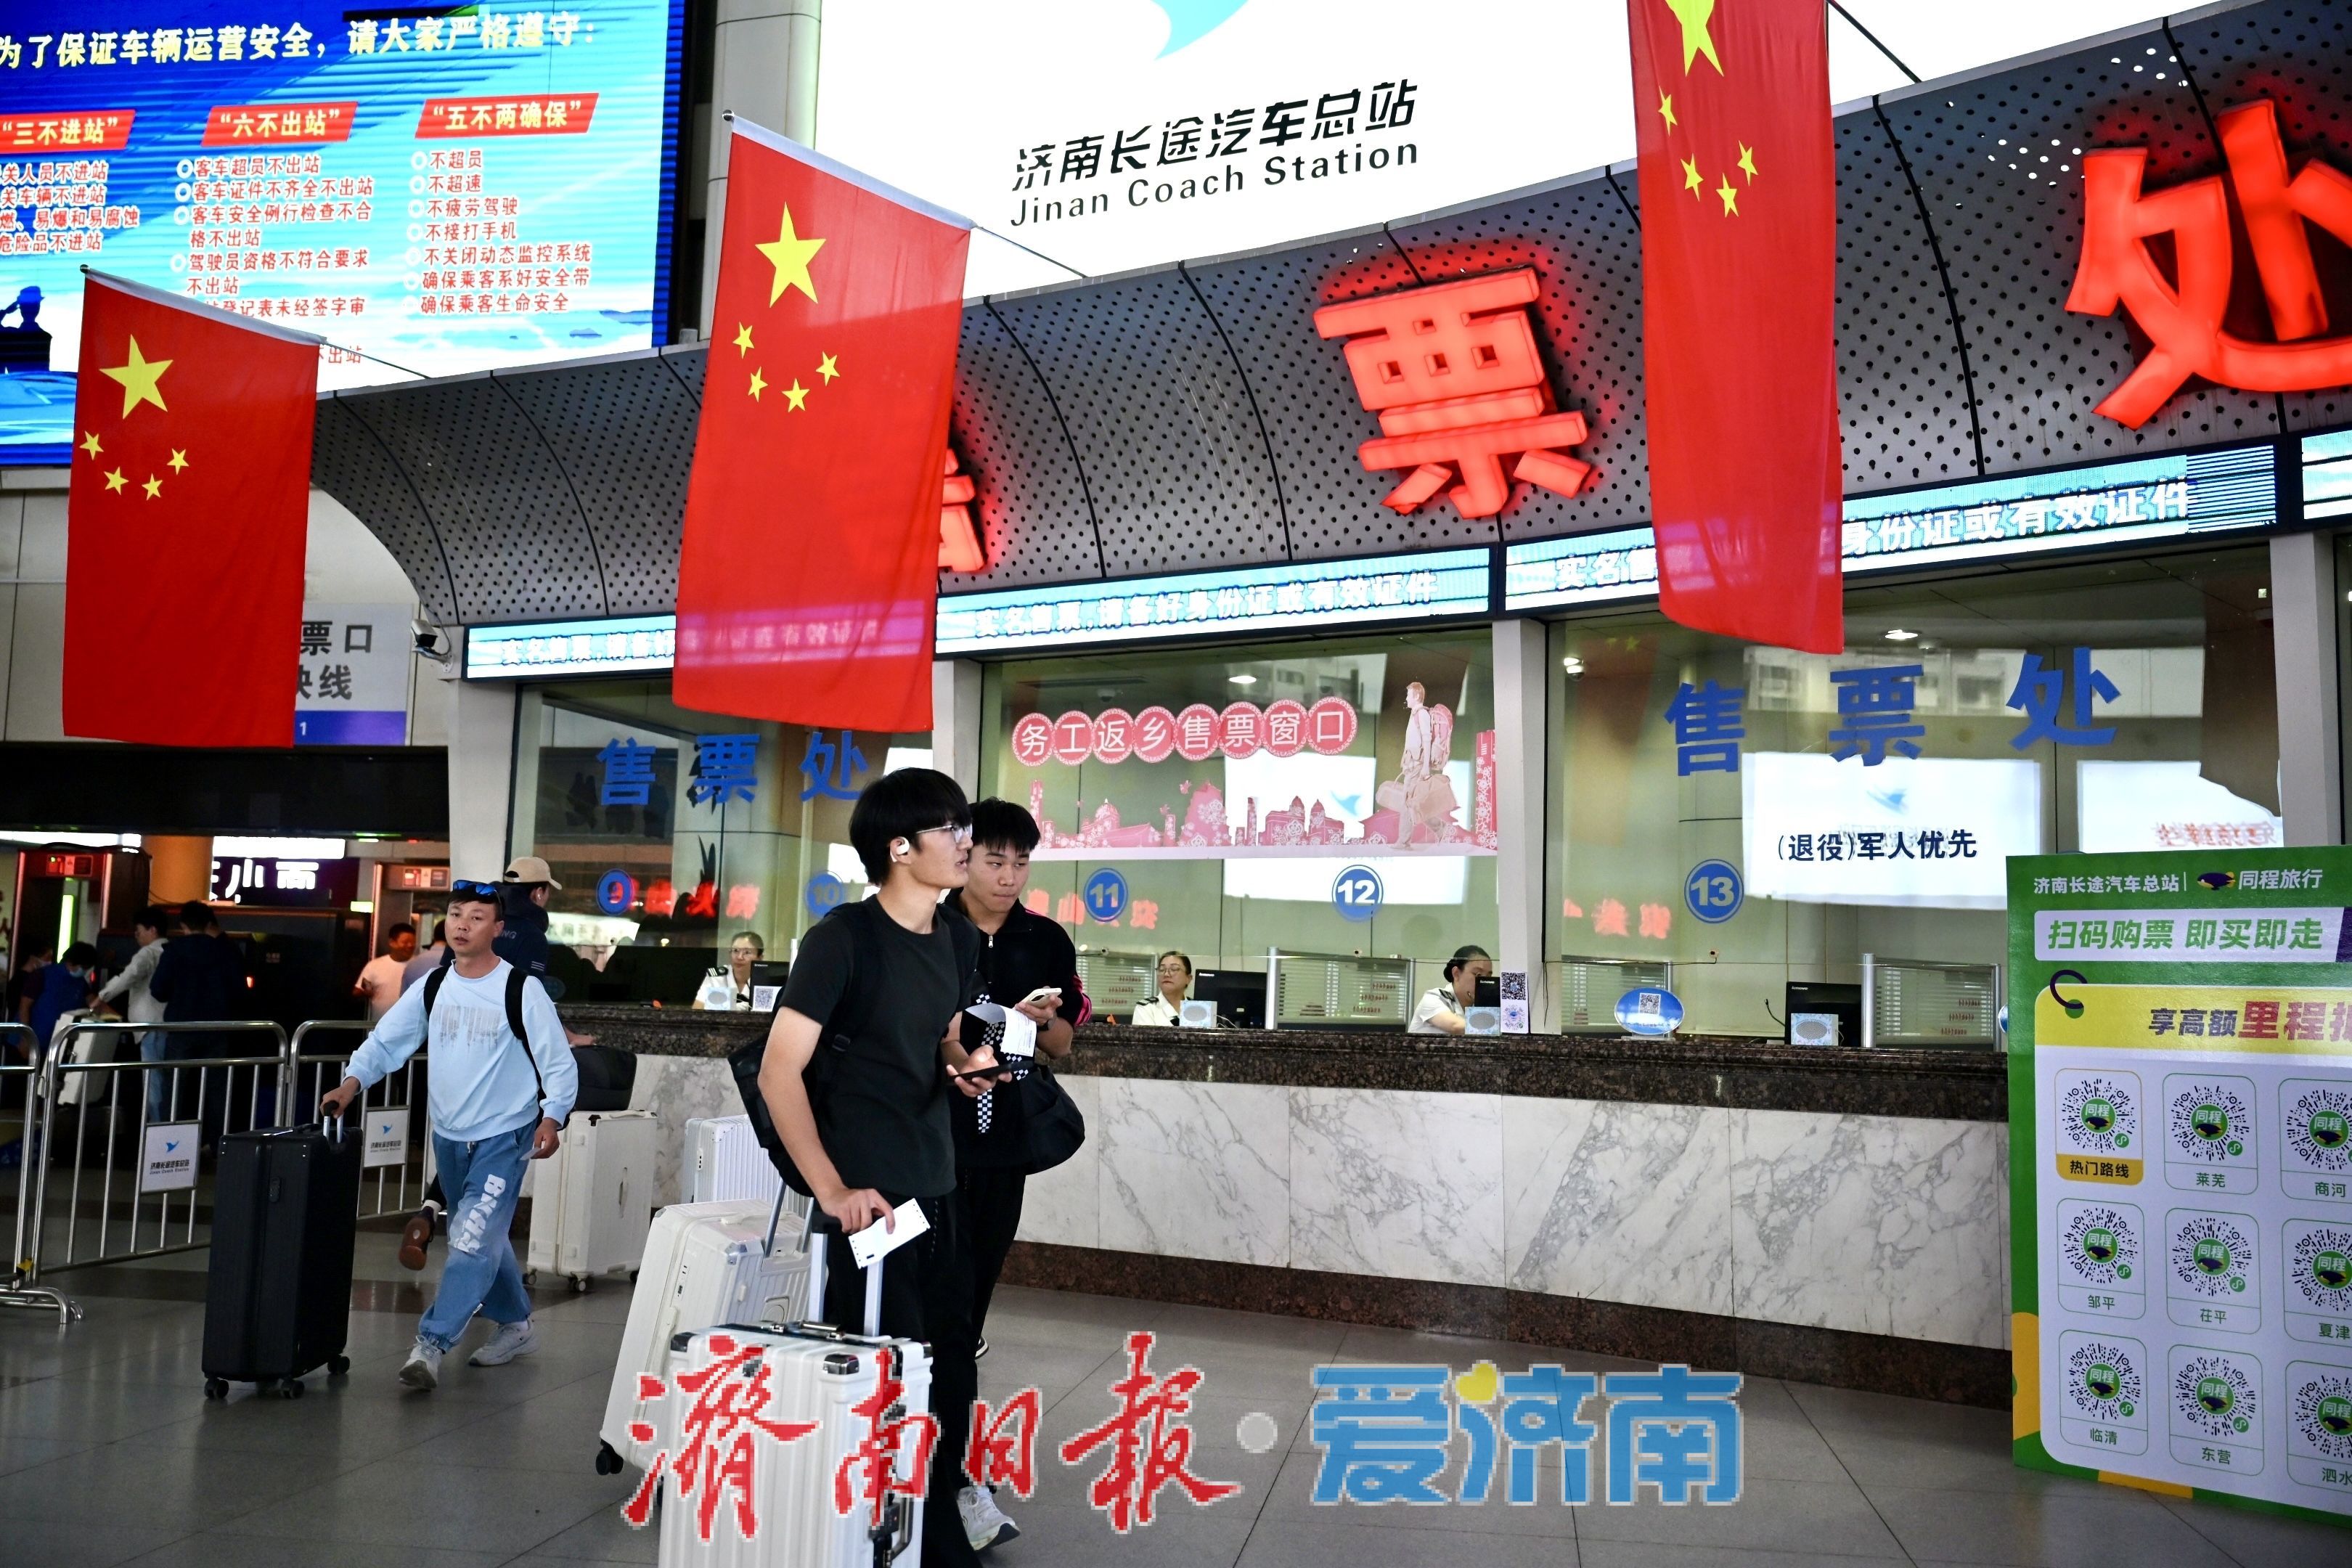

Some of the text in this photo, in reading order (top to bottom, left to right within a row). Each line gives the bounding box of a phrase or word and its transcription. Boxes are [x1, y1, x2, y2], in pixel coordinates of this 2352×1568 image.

[221, 109, 340, 138] “六不出站”
[433, 100, 581, 131] “五不两确保”
[2, 116, 118, 146] “三不进站”
[1012, 78, 1418, 192] 济南长途汽车总站
[196, 155, 320, 177] 客车超员不出站
[430, 150, 482, 169] 不超员
[193, 178, 374, 201] 客车证件不齐全不出站
[428, 174, 482, 193] 不超速
[1010, 142, 1418, 226] Jinan Coach Station
[192, 201, 372, 224] 客车安全例行检查不合
[427, 197, 518, 218] 不疲劳驾驶
[190, 229, 261, 248] 格不出站
[425, 221, 516, 242] 不接打手机
[189, 249, 368, 271] 驾驶员资格不符合要求
[424, 243, 591, 266] 不关闭动态监控系统
[187, 277, 239, 295] 不出站
[422, 268, 589, 290] 确保乘客系好安全带
[207, 297, 365, 317] 登记表未经签字审
[421, 292, 568, 314] 确保乘客生命安全
[1665, 647, 2120, 776] 售票处
[1021, 708, 1346, 757] 务工返乡售票窗口
[596, 730, 868, 807] 售票处
[1690, 875, 1735, 907] 13
[2034, 868, 2323, 894] 济南长途汽车总站 同程旅行
[608, 882, 624, 904] 9
[1090, 883, 1119, 907] 11
[1337, 880, 1376, 905] 12
[2048, 917, 2324, 950] 扫码购票 即买即走
[2085, 1103, 2110, 1118] 同程
[2194, 1109, 2221, 1124] 同程
[2314, 1114, 2342, 1131] 同程
[2070, 1160, 2130, 1179] 热门路线
[2195, 1172, 2226, 1188] 莱芜
[2314, 1181, 2346, 1198] 商河
[2086, 1233, 2112, 1247] 同程
[2197, 1243, 2224, 1259] 同程
[2317, 1255, 2346, 1272] 同程
[2087, 1294, 2115, 1310] 邹平
[2200, 1309, 2227, 1325] 茌平
[2318, 1322, 2351, 1340] 夏津
[2089, 1368, 2115, 1383] 同程
[2200, 1382, 2228, 1398] 同程
[2322, 1400, 2352, 1418] 同程
[2089, 1428, 2118, 1445] 临清
[2200, 1447, 2231, 1465] 东营
[2321, 1467, 2352, 1485] 泗水
